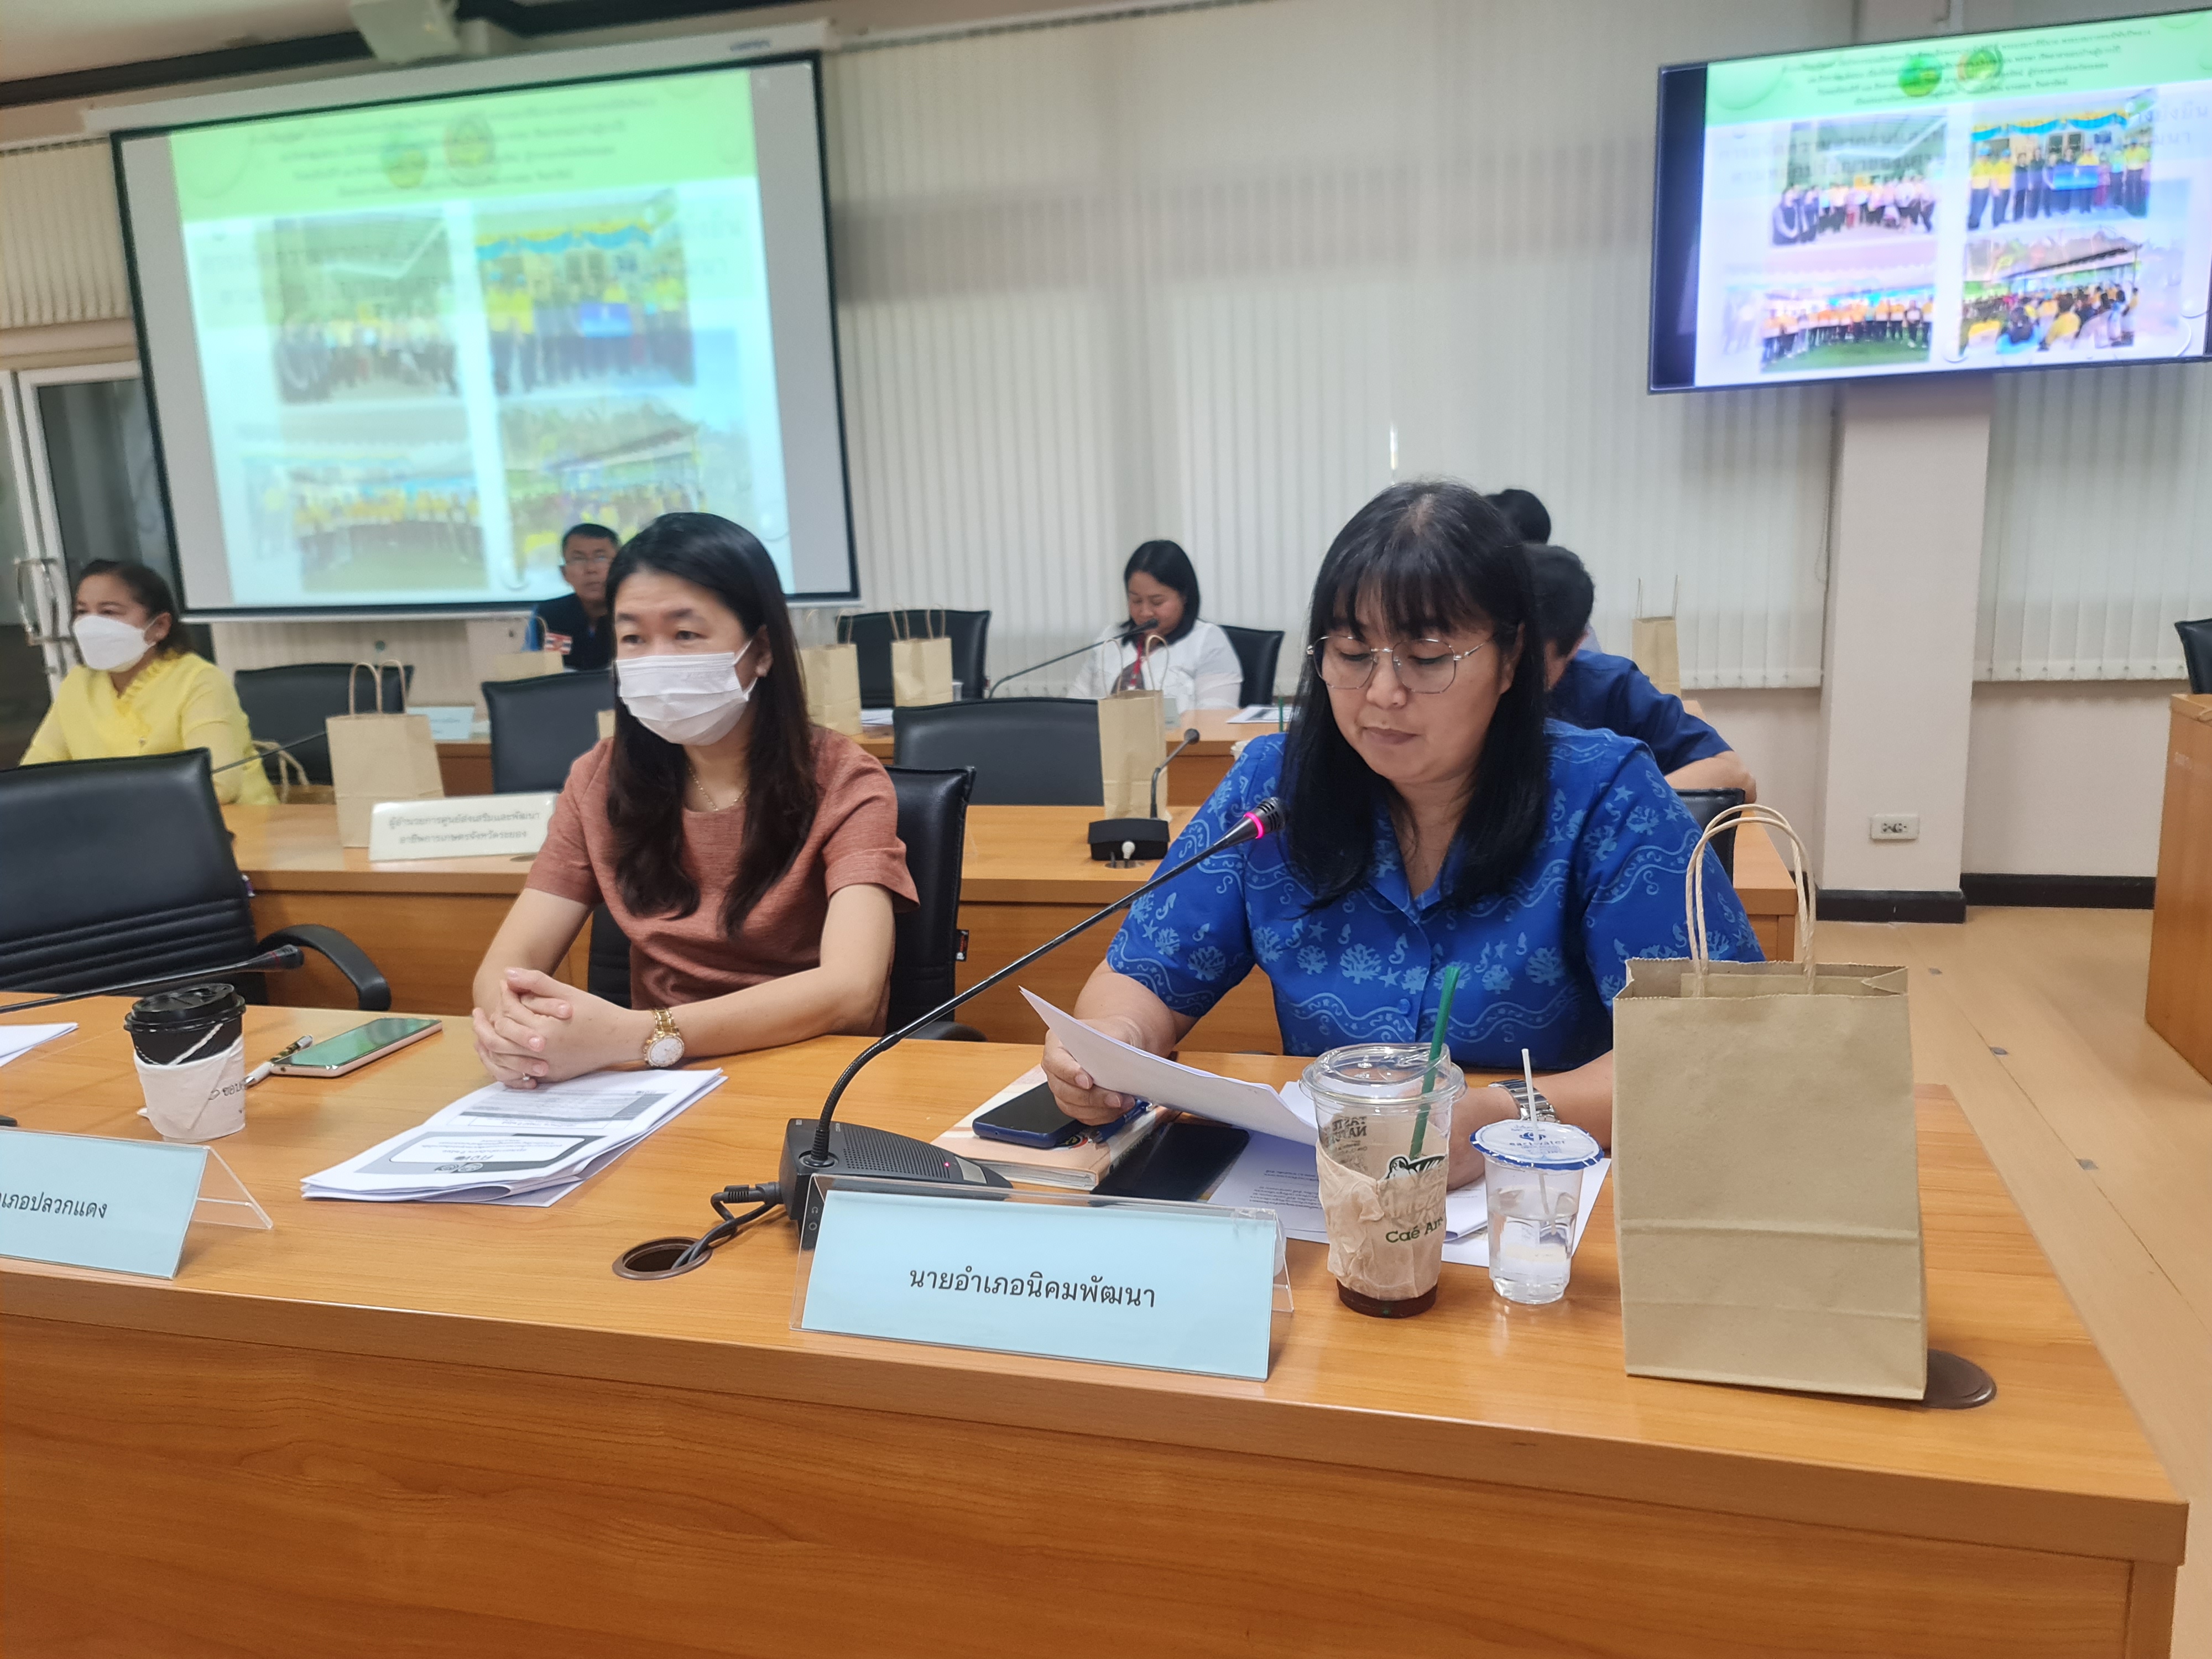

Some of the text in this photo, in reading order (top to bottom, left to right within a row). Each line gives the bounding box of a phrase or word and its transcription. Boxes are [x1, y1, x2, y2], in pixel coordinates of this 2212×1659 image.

[0, 1191, 108, 1219] เภอปลวกแดง
[910, 1265, 1155, 1308] นายอำเภอนิคมพัฒนา
